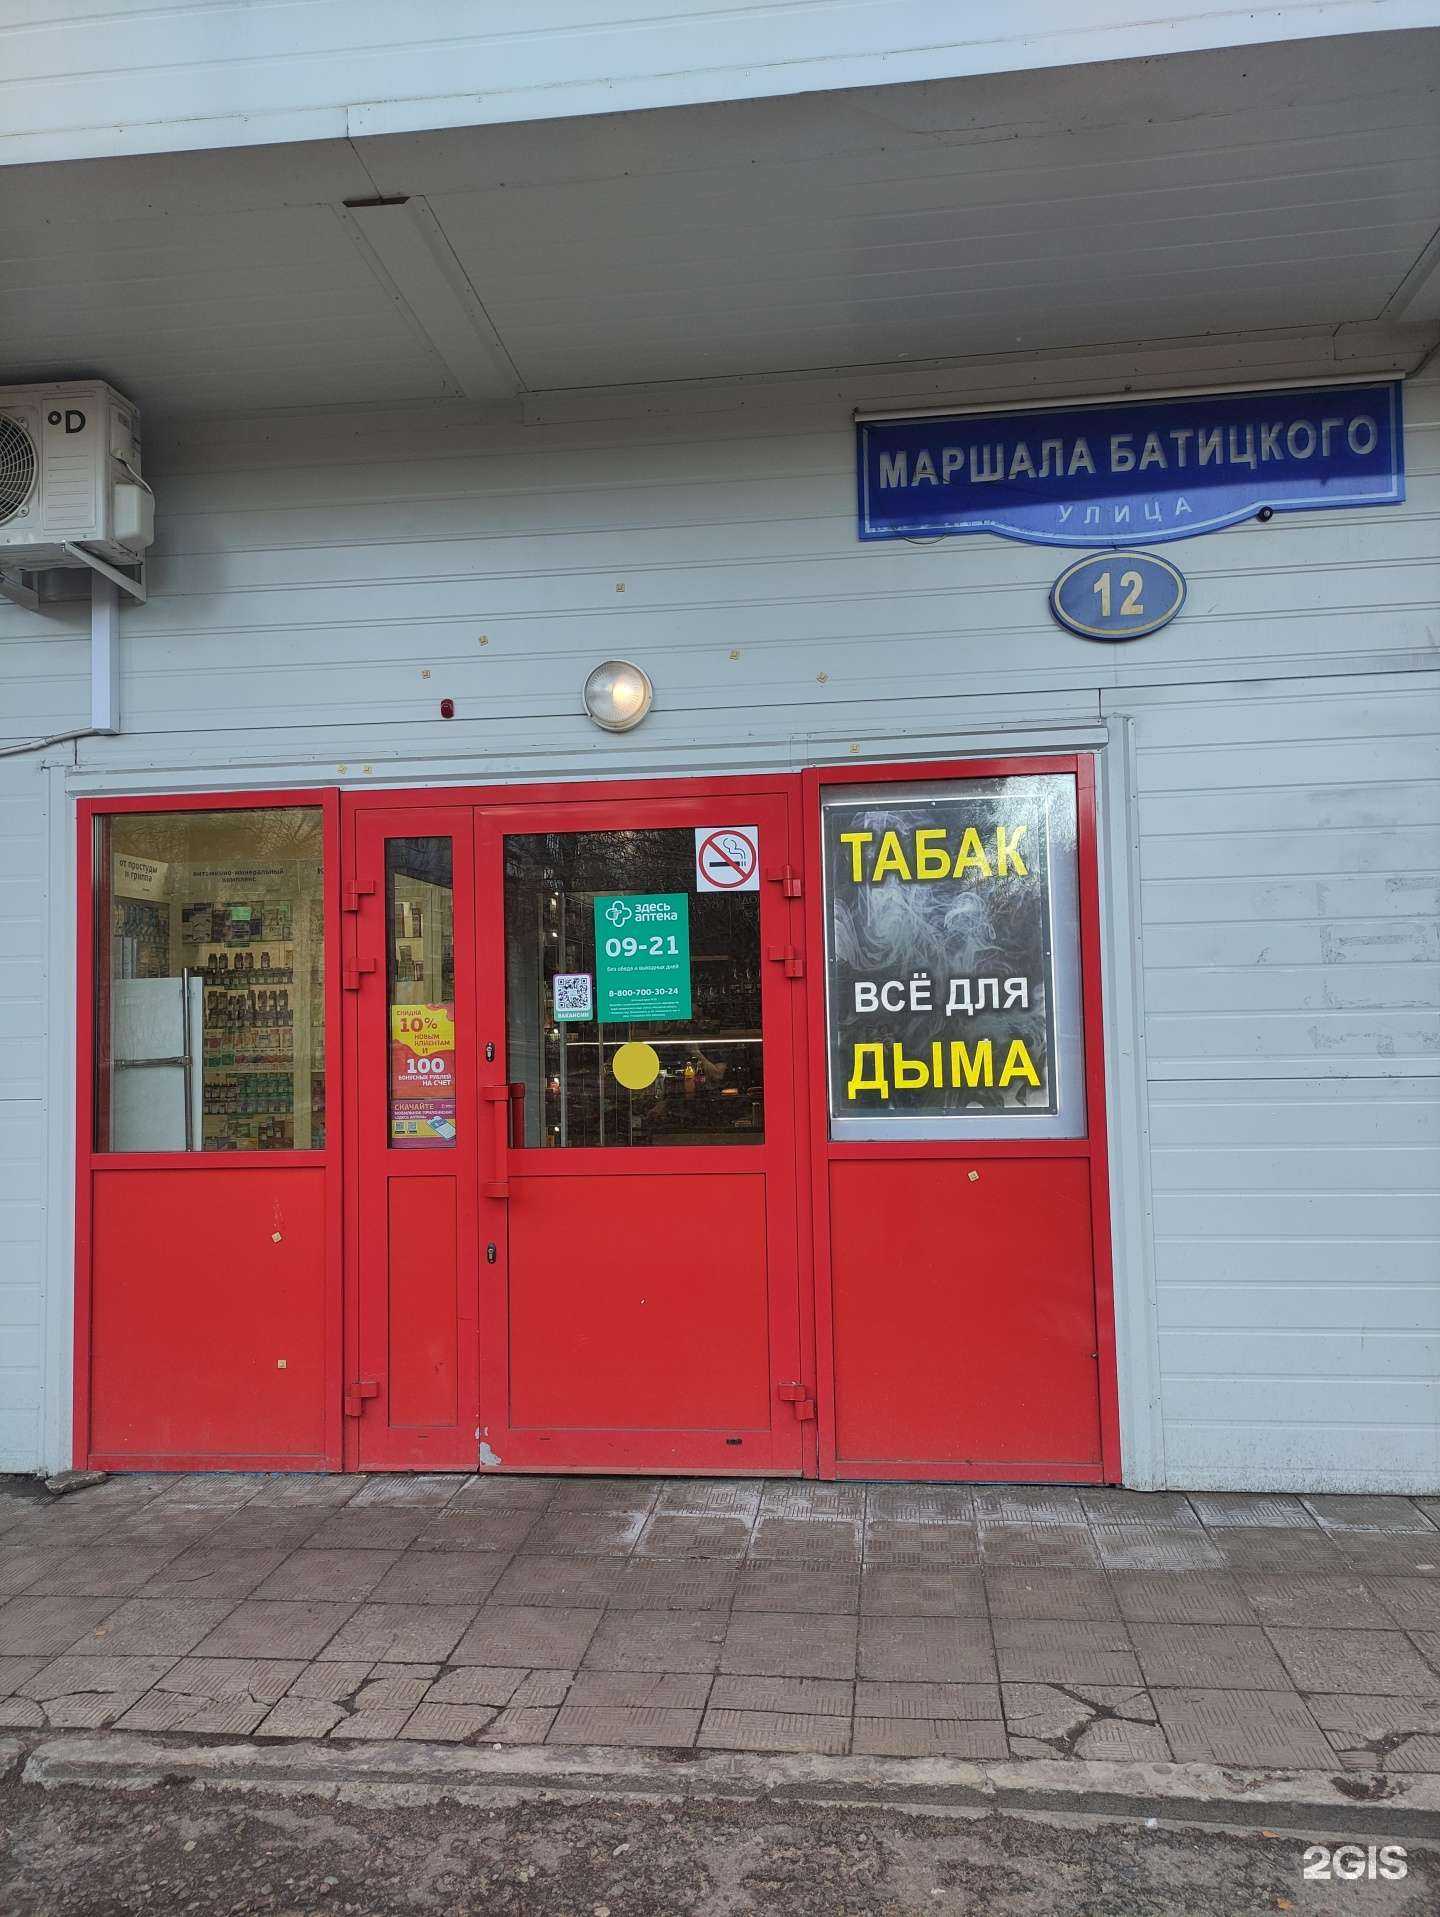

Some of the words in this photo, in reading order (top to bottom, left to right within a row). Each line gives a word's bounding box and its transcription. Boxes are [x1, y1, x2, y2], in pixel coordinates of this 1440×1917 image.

[878, 437, 1096, 489] МАРШАЛА
[1110, 415, 1378, 474] БАТИЦКОГО
[1057, 495, 1192, 524] УЛИЦА
[1093, 571, 1144, 617] 12
[840, 825, 1028, 882] ТАБАК
[634, 902, 671, 913] здесь
[634, 911, 679, 922] аптека
[605, 935, 679, 957] 09-21
[608, 987, 679, 997] 8-800-700-30-24
[854, 972, 933, 1012] ВСЁ
[946, 977, 1029, 1016] ДЛЯ
[400, 1017, 438, 1033] 10%
[407, 1057, 446, 1074] 100
[847, 1039, 1041, 1100] ДЫМА
